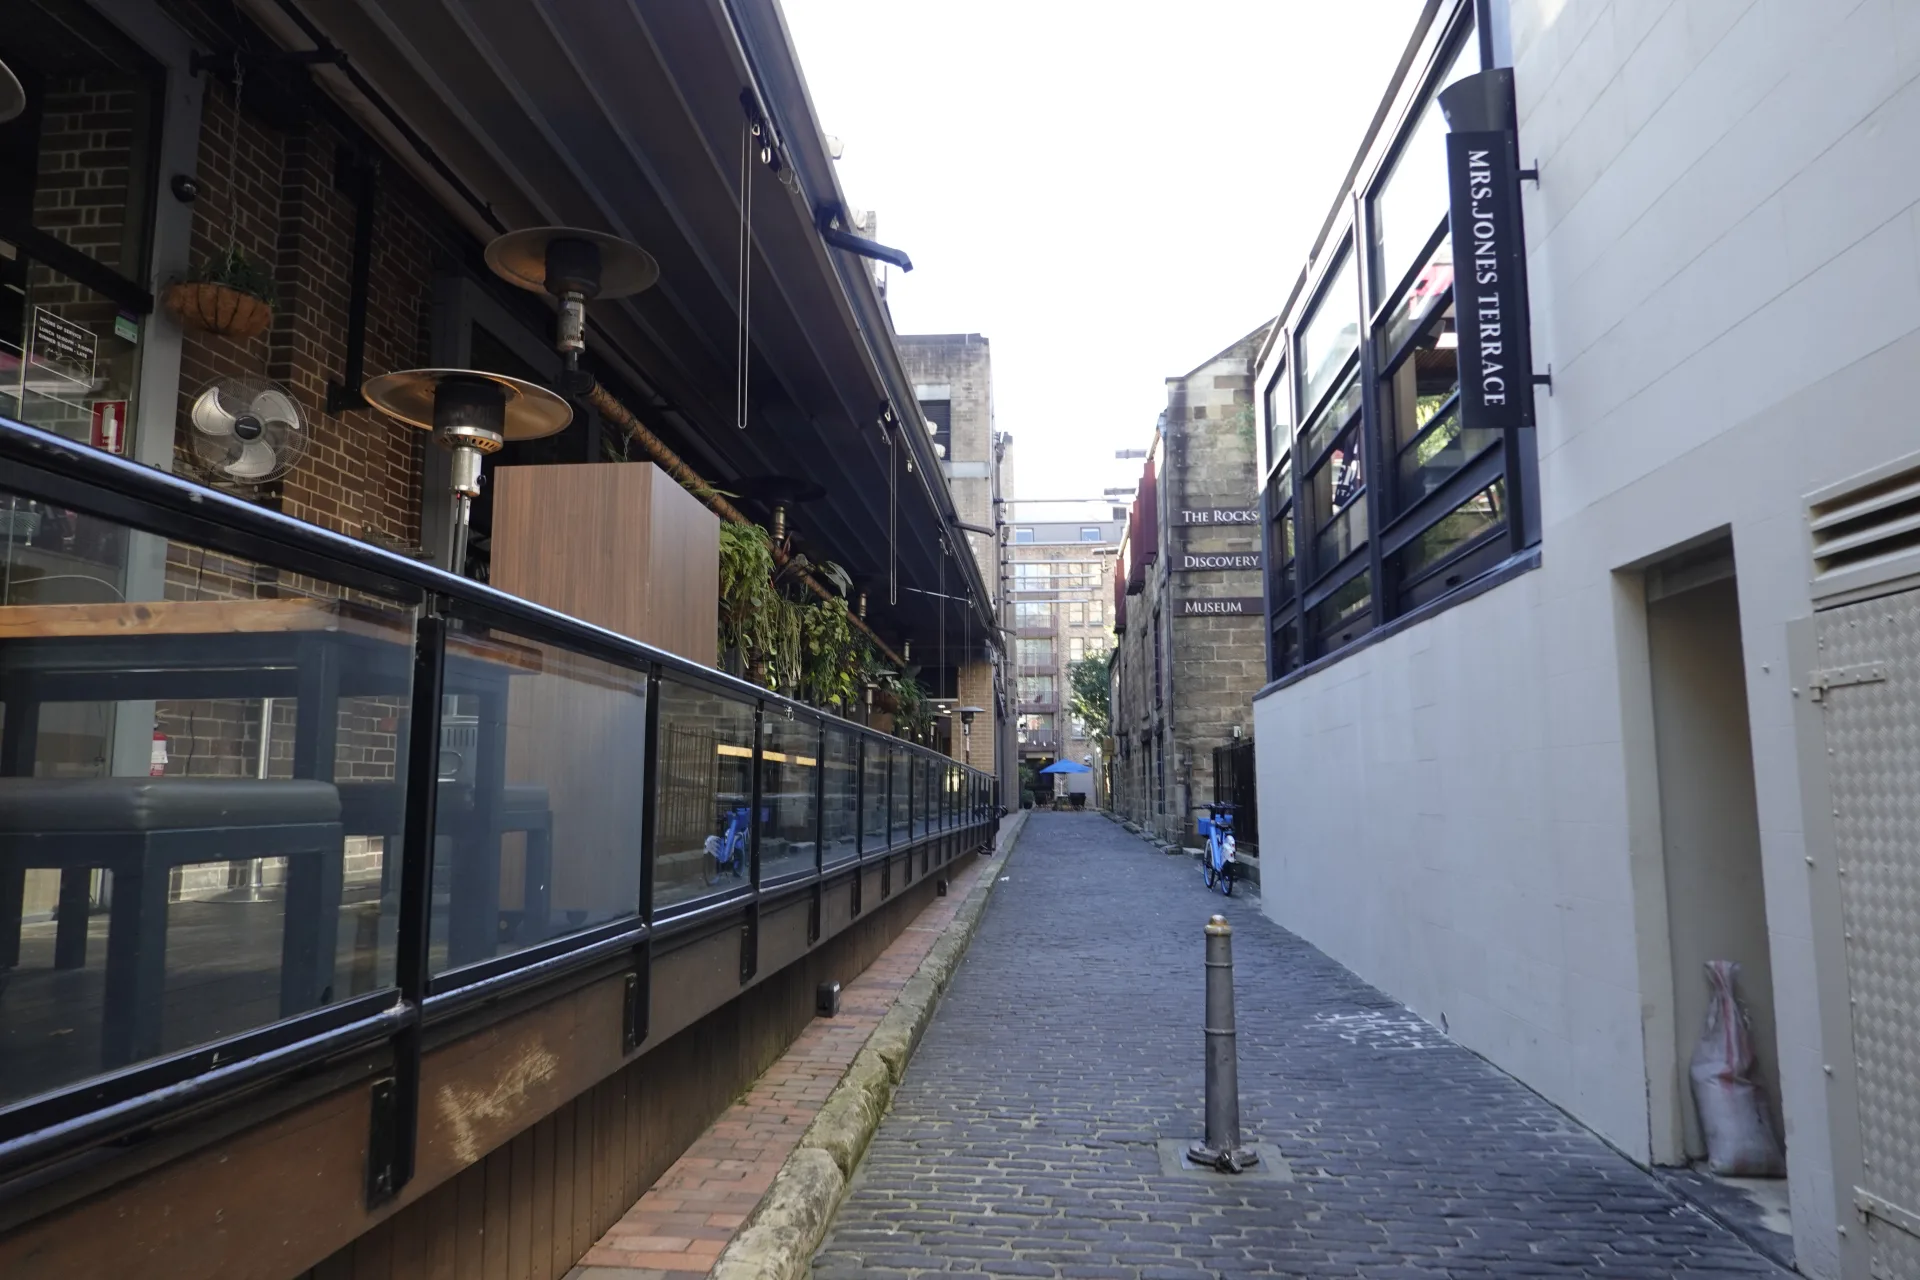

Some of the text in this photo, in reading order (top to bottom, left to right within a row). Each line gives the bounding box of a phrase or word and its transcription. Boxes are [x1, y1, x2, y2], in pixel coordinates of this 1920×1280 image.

[1478, 292, 1506, 406] TERRACE
[1182, 510, 1259, 523] THE ROCKS
[1184, 555, 1259, 568] DISCOVERY
[1184, 601, 1243, 613] MUSEUM
